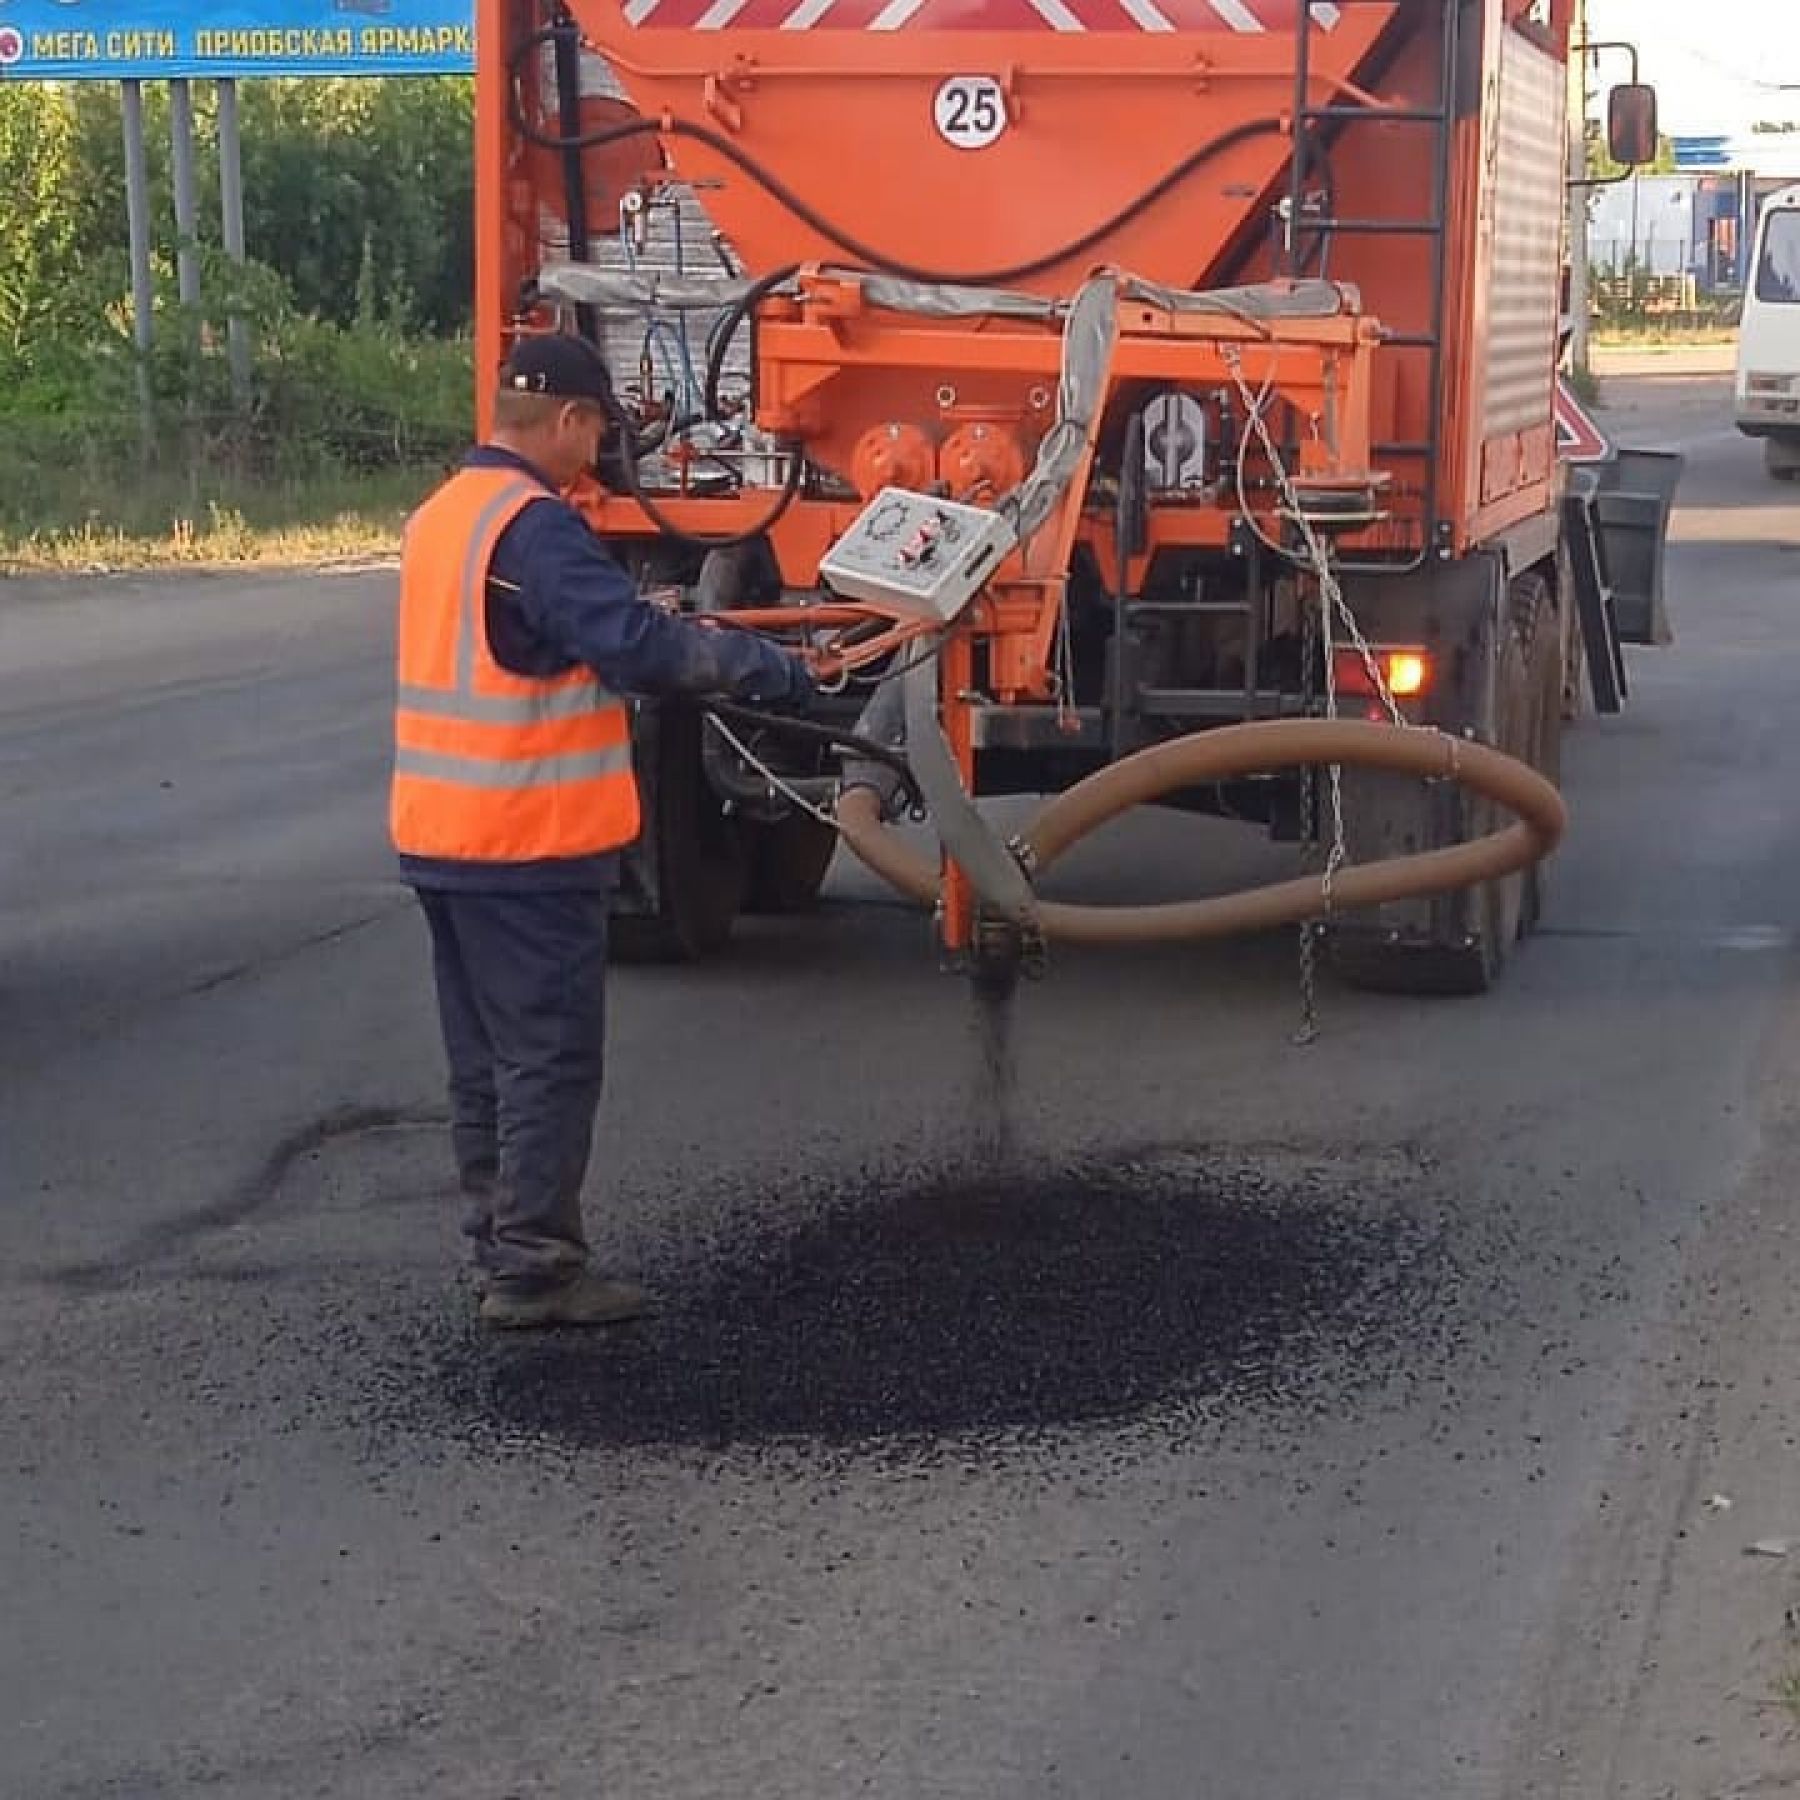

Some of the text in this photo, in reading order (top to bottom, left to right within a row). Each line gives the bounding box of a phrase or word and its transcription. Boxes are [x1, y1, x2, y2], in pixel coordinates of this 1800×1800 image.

[33, 26, 474, 59] МЕГА СИТИ ПРИОБСКАЯ ЯРМАРК
[946, 87, 996, 131] 25
